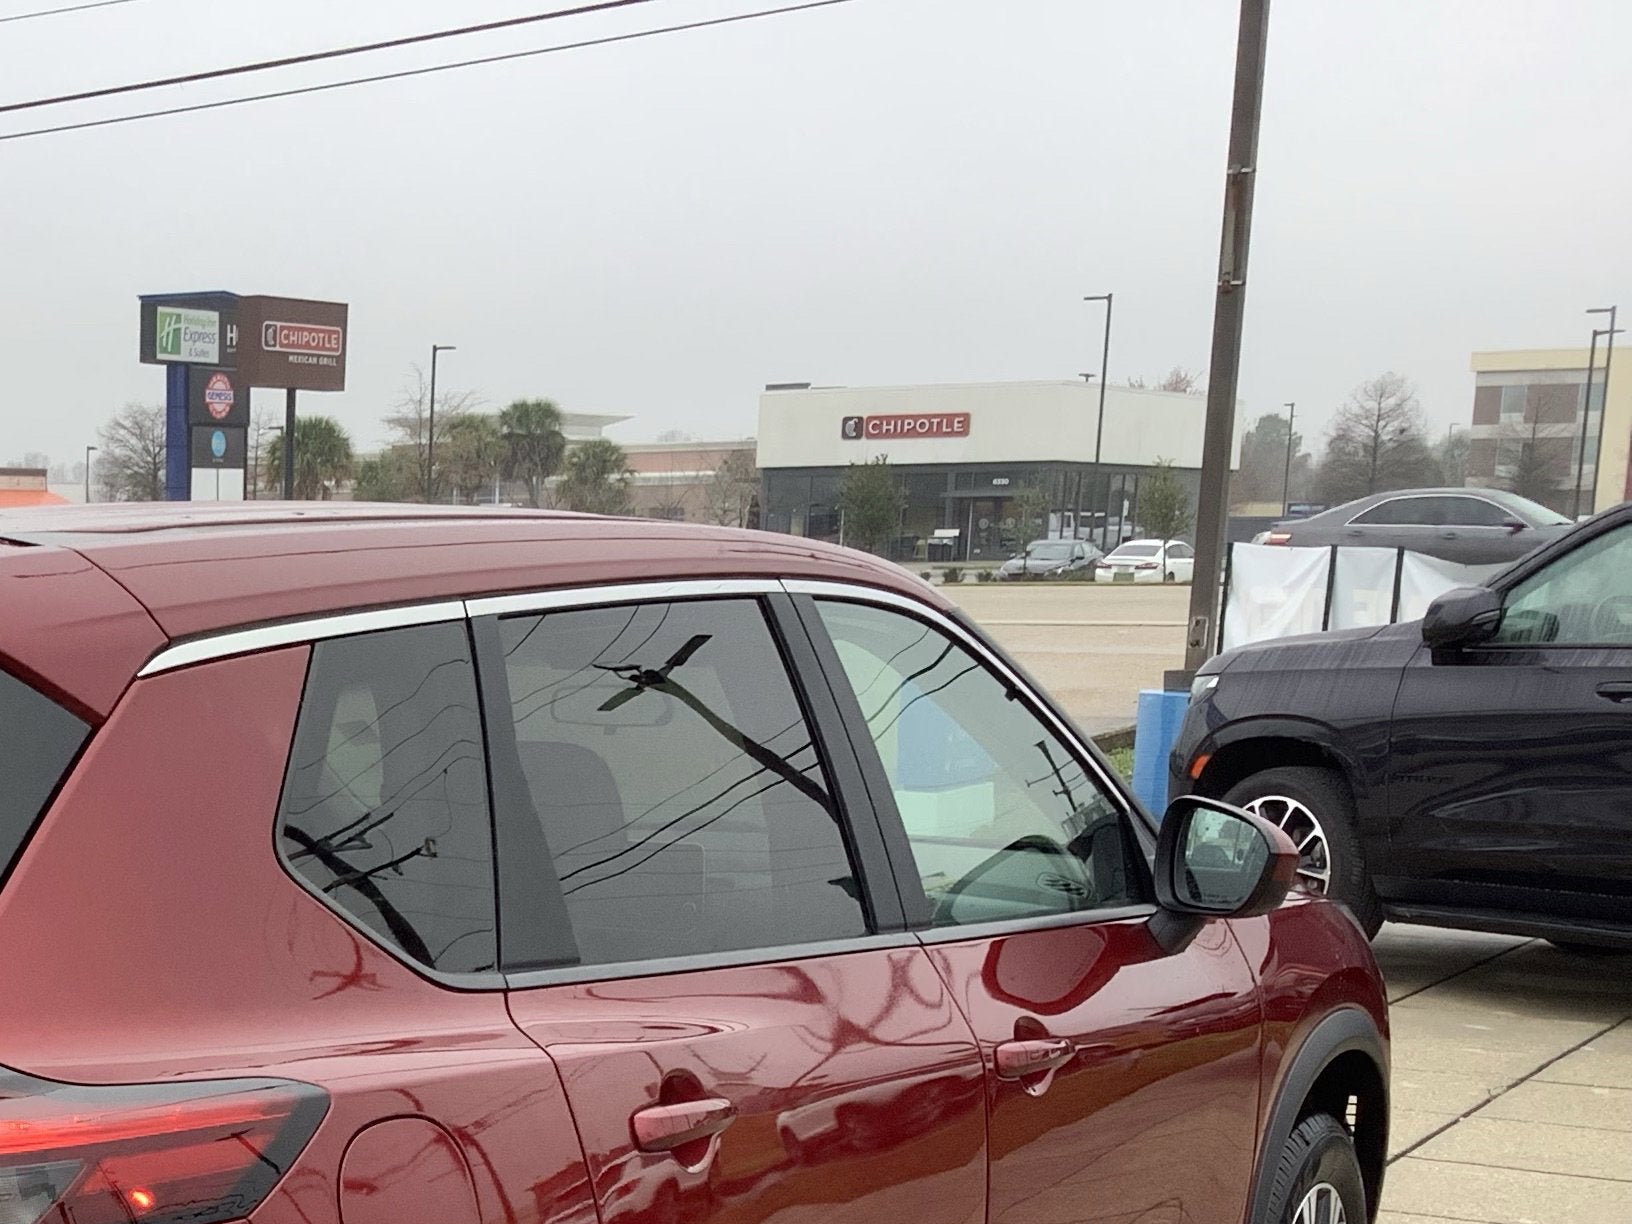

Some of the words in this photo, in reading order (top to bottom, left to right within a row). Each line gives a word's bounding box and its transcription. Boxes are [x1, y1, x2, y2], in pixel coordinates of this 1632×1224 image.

[183, 326, 216, 346] Express
[226, 324, 239, 347] H
[280, 329, 338, 348] CHIPOTLE
[288, 355, 317, 365] MEXICAN
[318, 356, 337, 367] GRILL
[868, 417, 965, 434] CHIPOTLE
